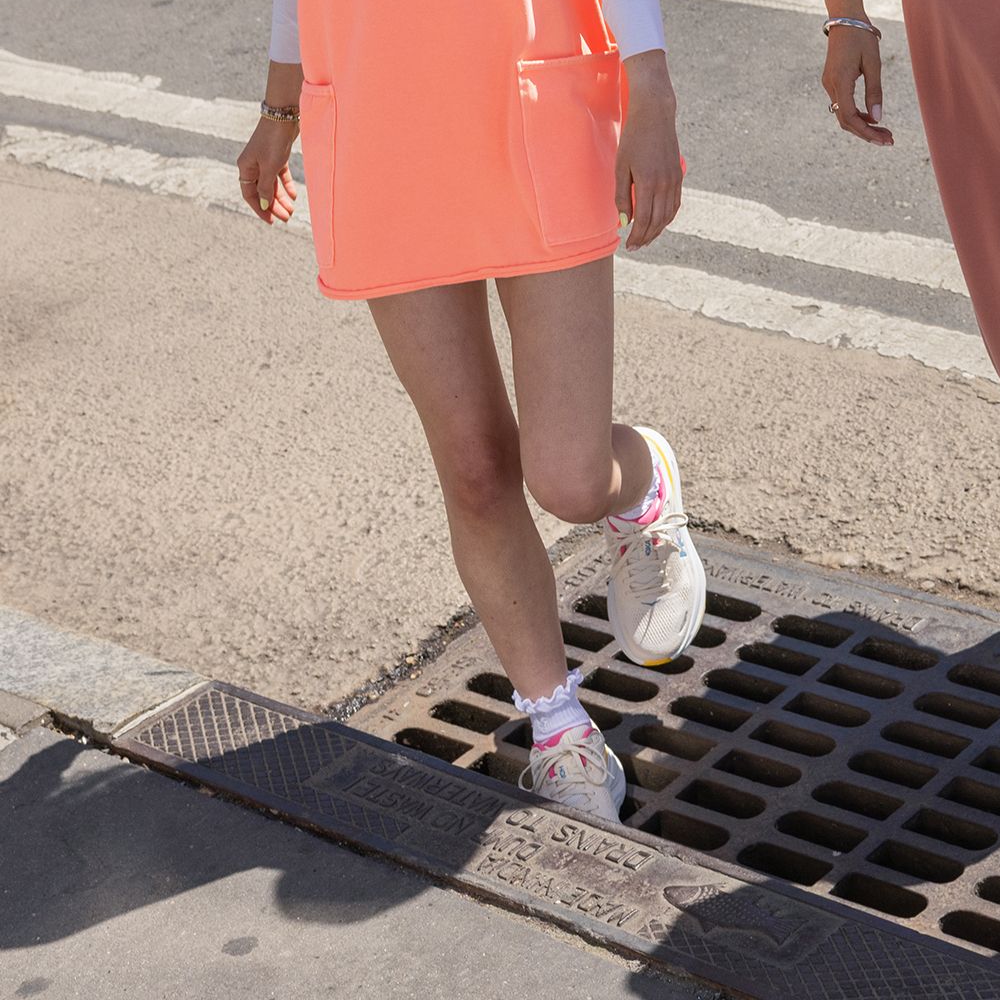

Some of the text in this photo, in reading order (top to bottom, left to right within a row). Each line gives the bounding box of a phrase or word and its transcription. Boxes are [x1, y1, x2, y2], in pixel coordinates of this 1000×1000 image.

[369, 759, 654, 872] DRAINS TO WATERWAYS
[431, 811, 478, 836] NO
[470, 828, 543, 862] DUMP
[560, 886, 639, 927] MADE
